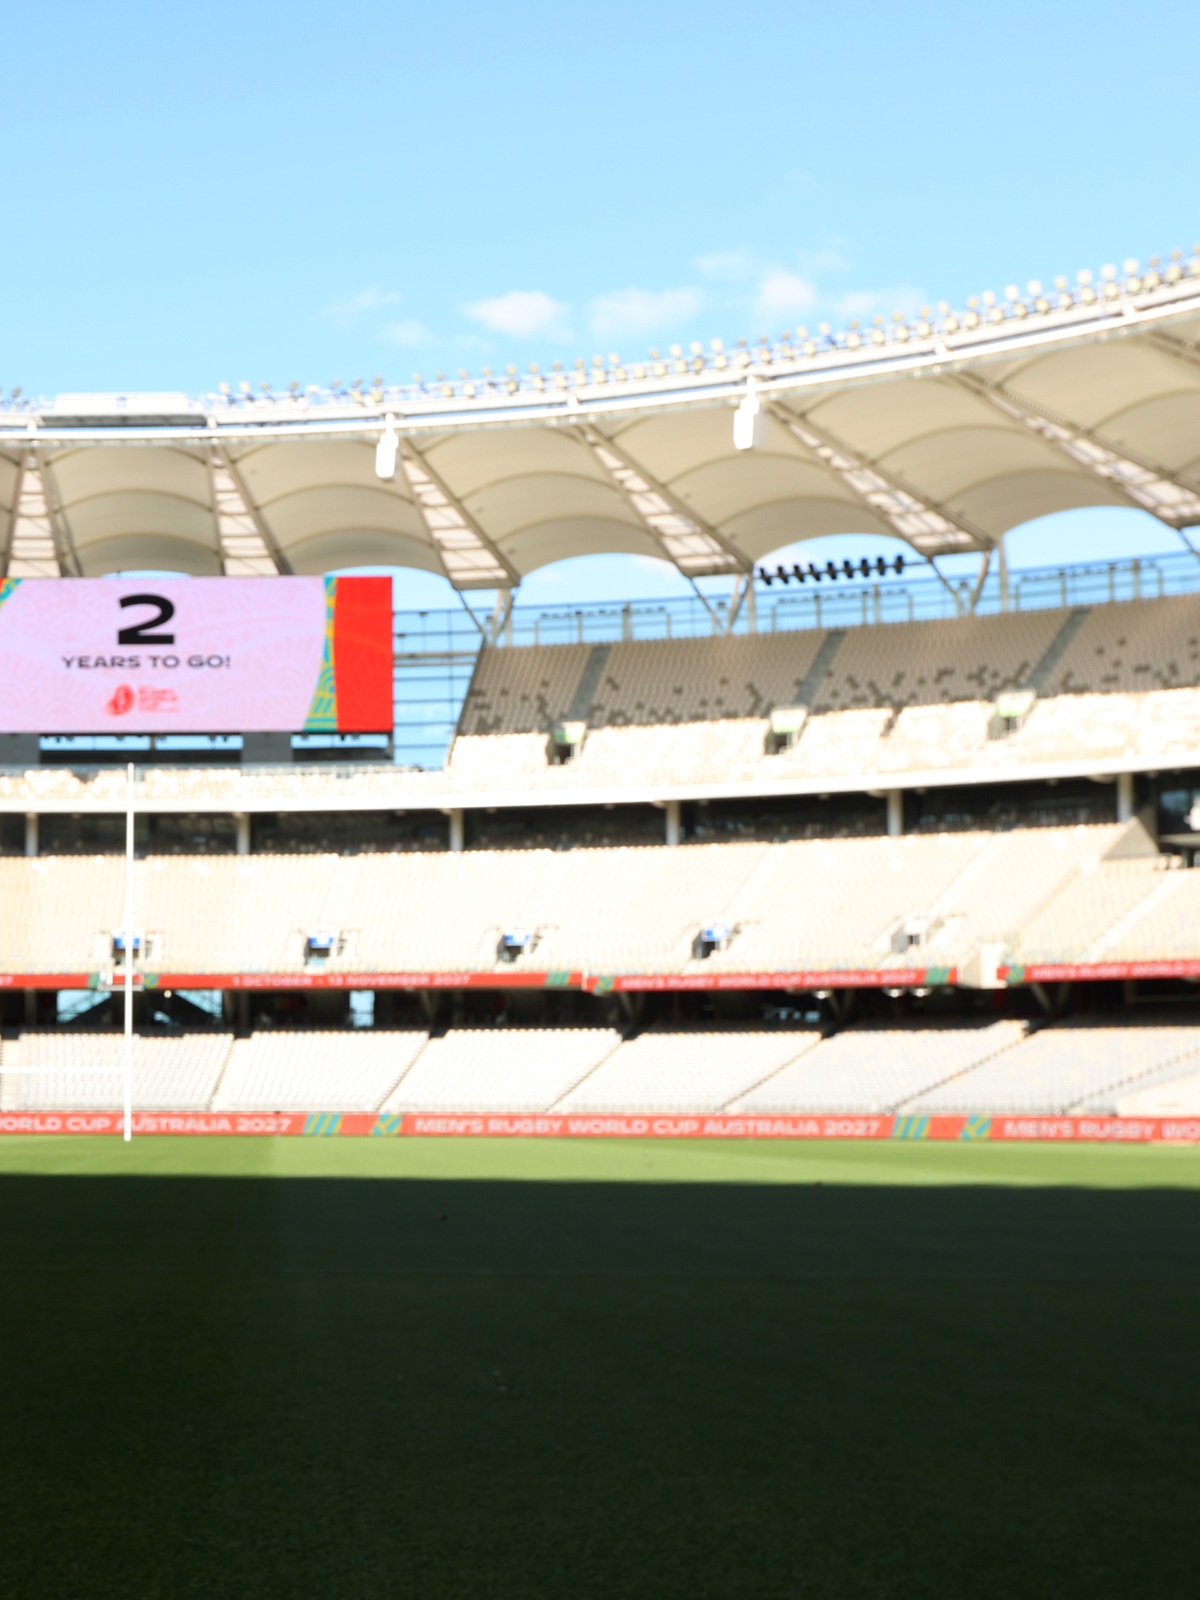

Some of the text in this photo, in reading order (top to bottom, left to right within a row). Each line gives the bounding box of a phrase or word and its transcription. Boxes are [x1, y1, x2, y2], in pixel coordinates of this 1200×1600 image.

[118, 593, 175, 645] 2
[62, 654, 231, 669] YEARS TO GO!
[242, 975, 312, 986] OCTOBER
[433, 974, 471, 986] 2027
[65, 1117, 111, 1131] CUP
[236, 1118, 292, 1132] 2027
[415, 1118, 881, 1136] MEN'S RUGBY WORLD CUP AUSTRALIA 2027
[1004, 1121, 1074, 1138] MEN'S
[1078, 1121, 1156, 1138] RUGBY
